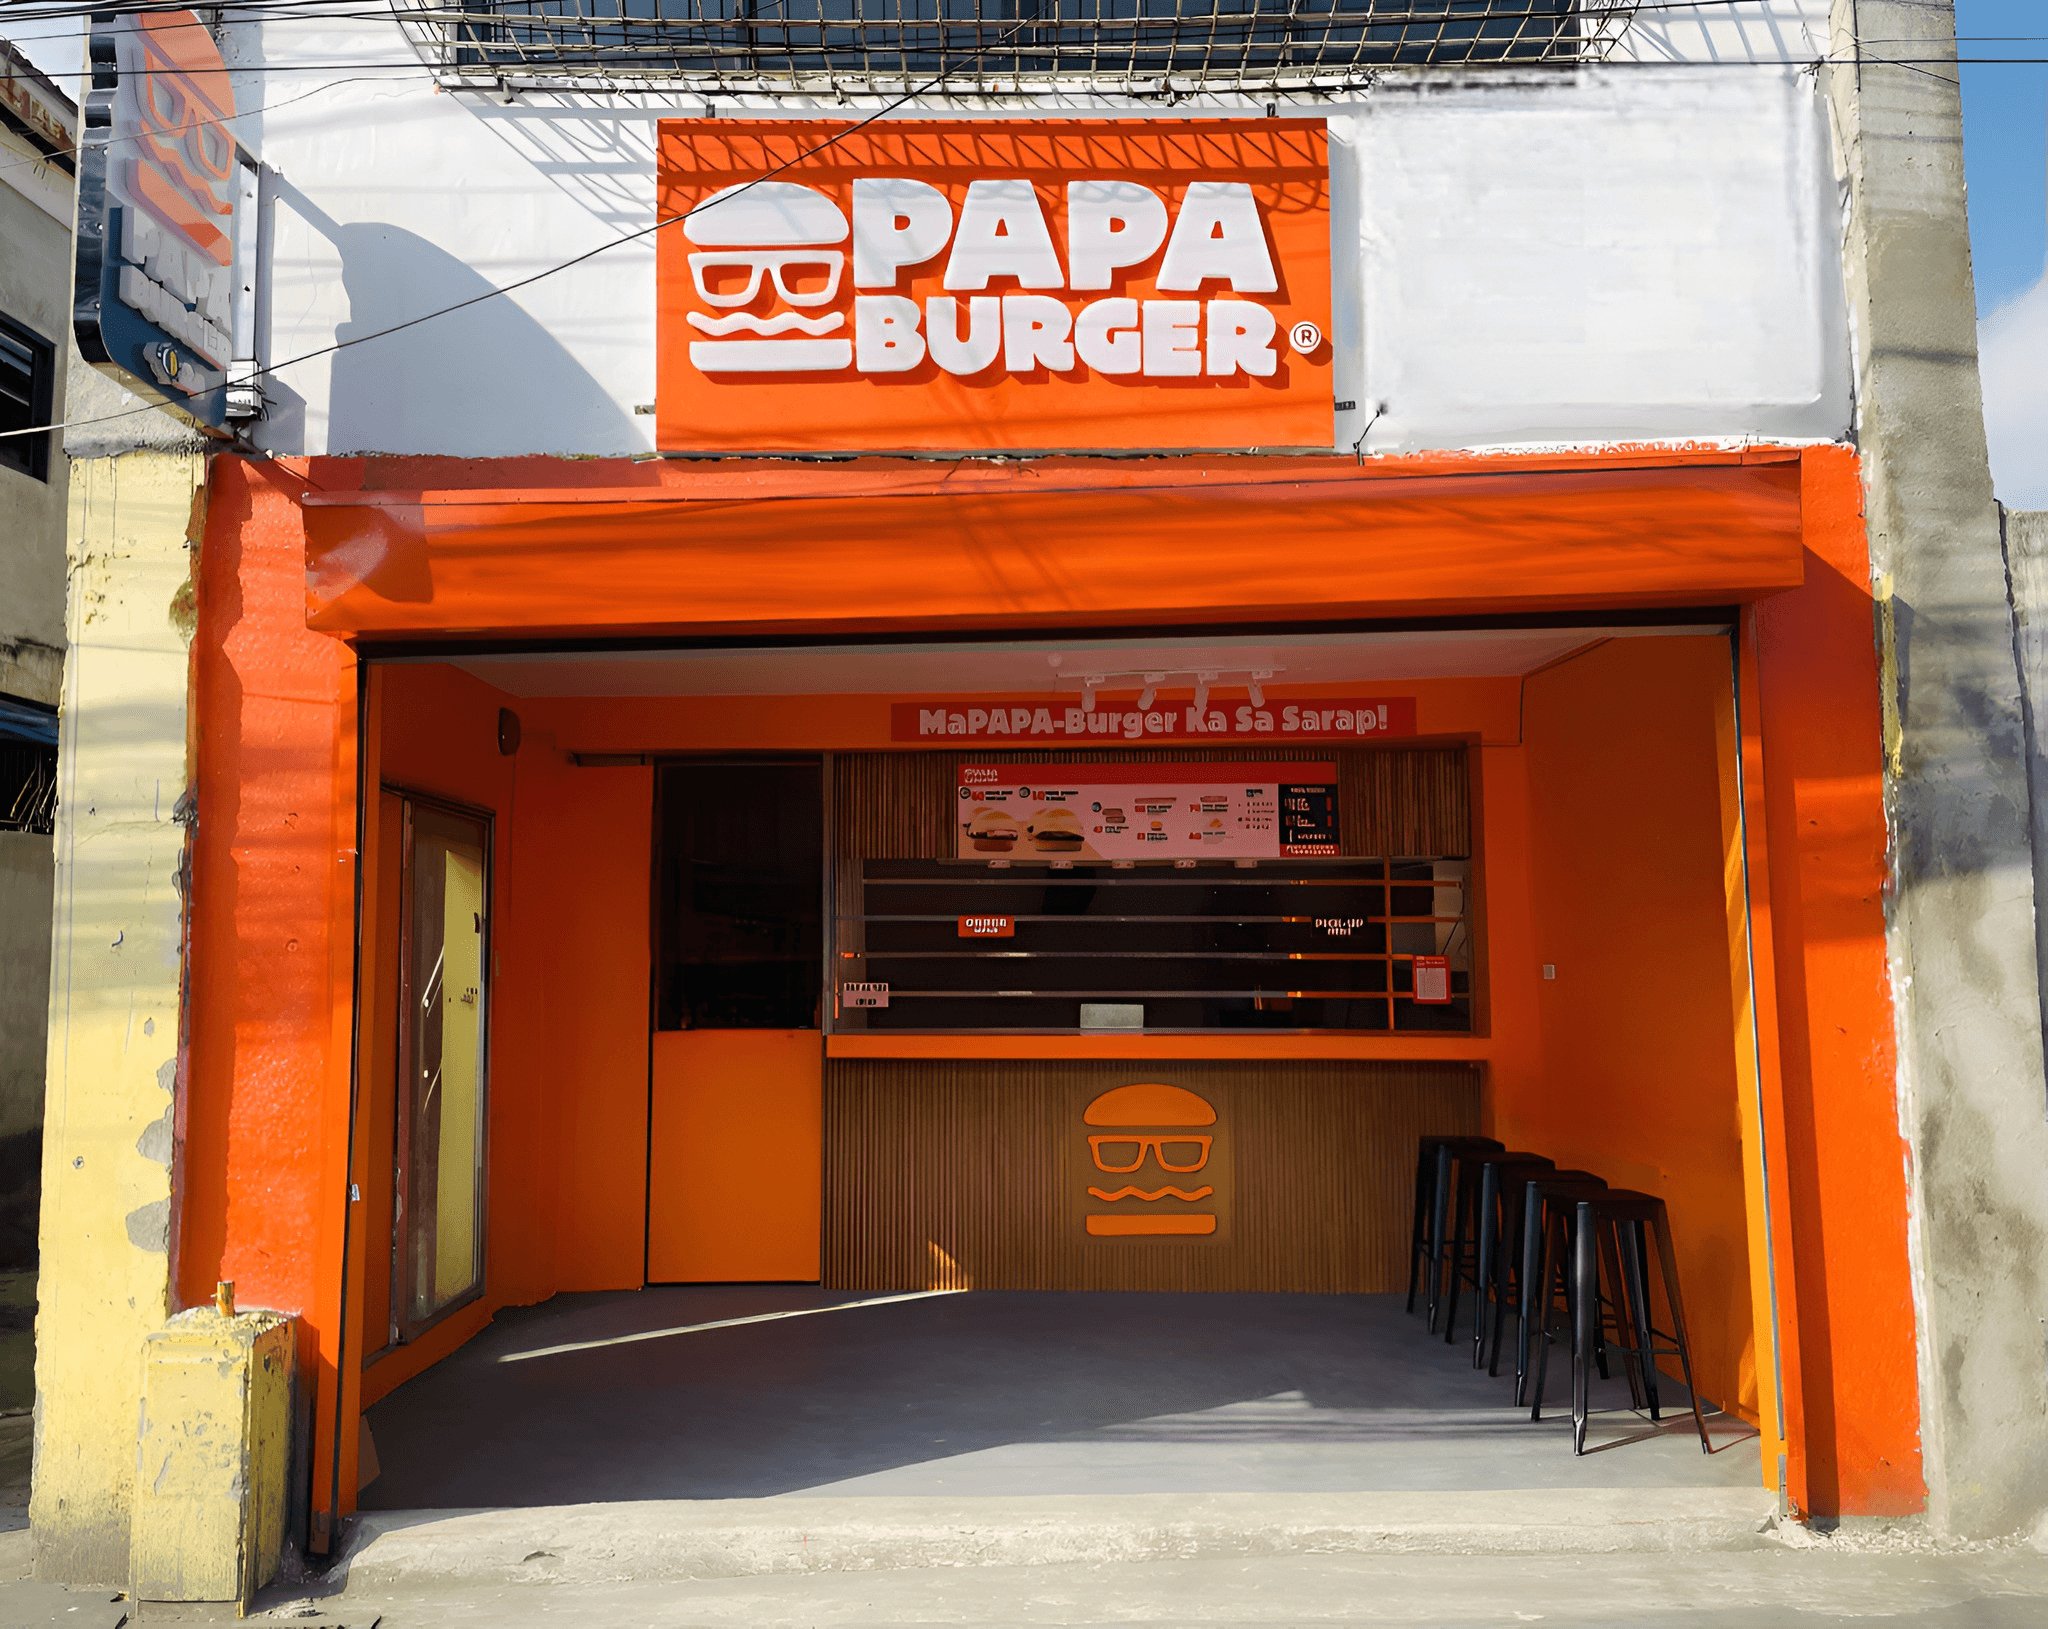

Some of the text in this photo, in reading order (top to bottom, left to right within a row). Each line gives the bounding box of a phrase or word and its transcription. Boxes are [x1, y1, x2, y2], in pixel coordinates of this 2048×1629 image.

[852, 178, 1278, 292] PAPA
[855, 294, 1277, 377] BURGER
[918, 704, 1389, 739] MaPAPA-Burger Ka Sa Sarap!
